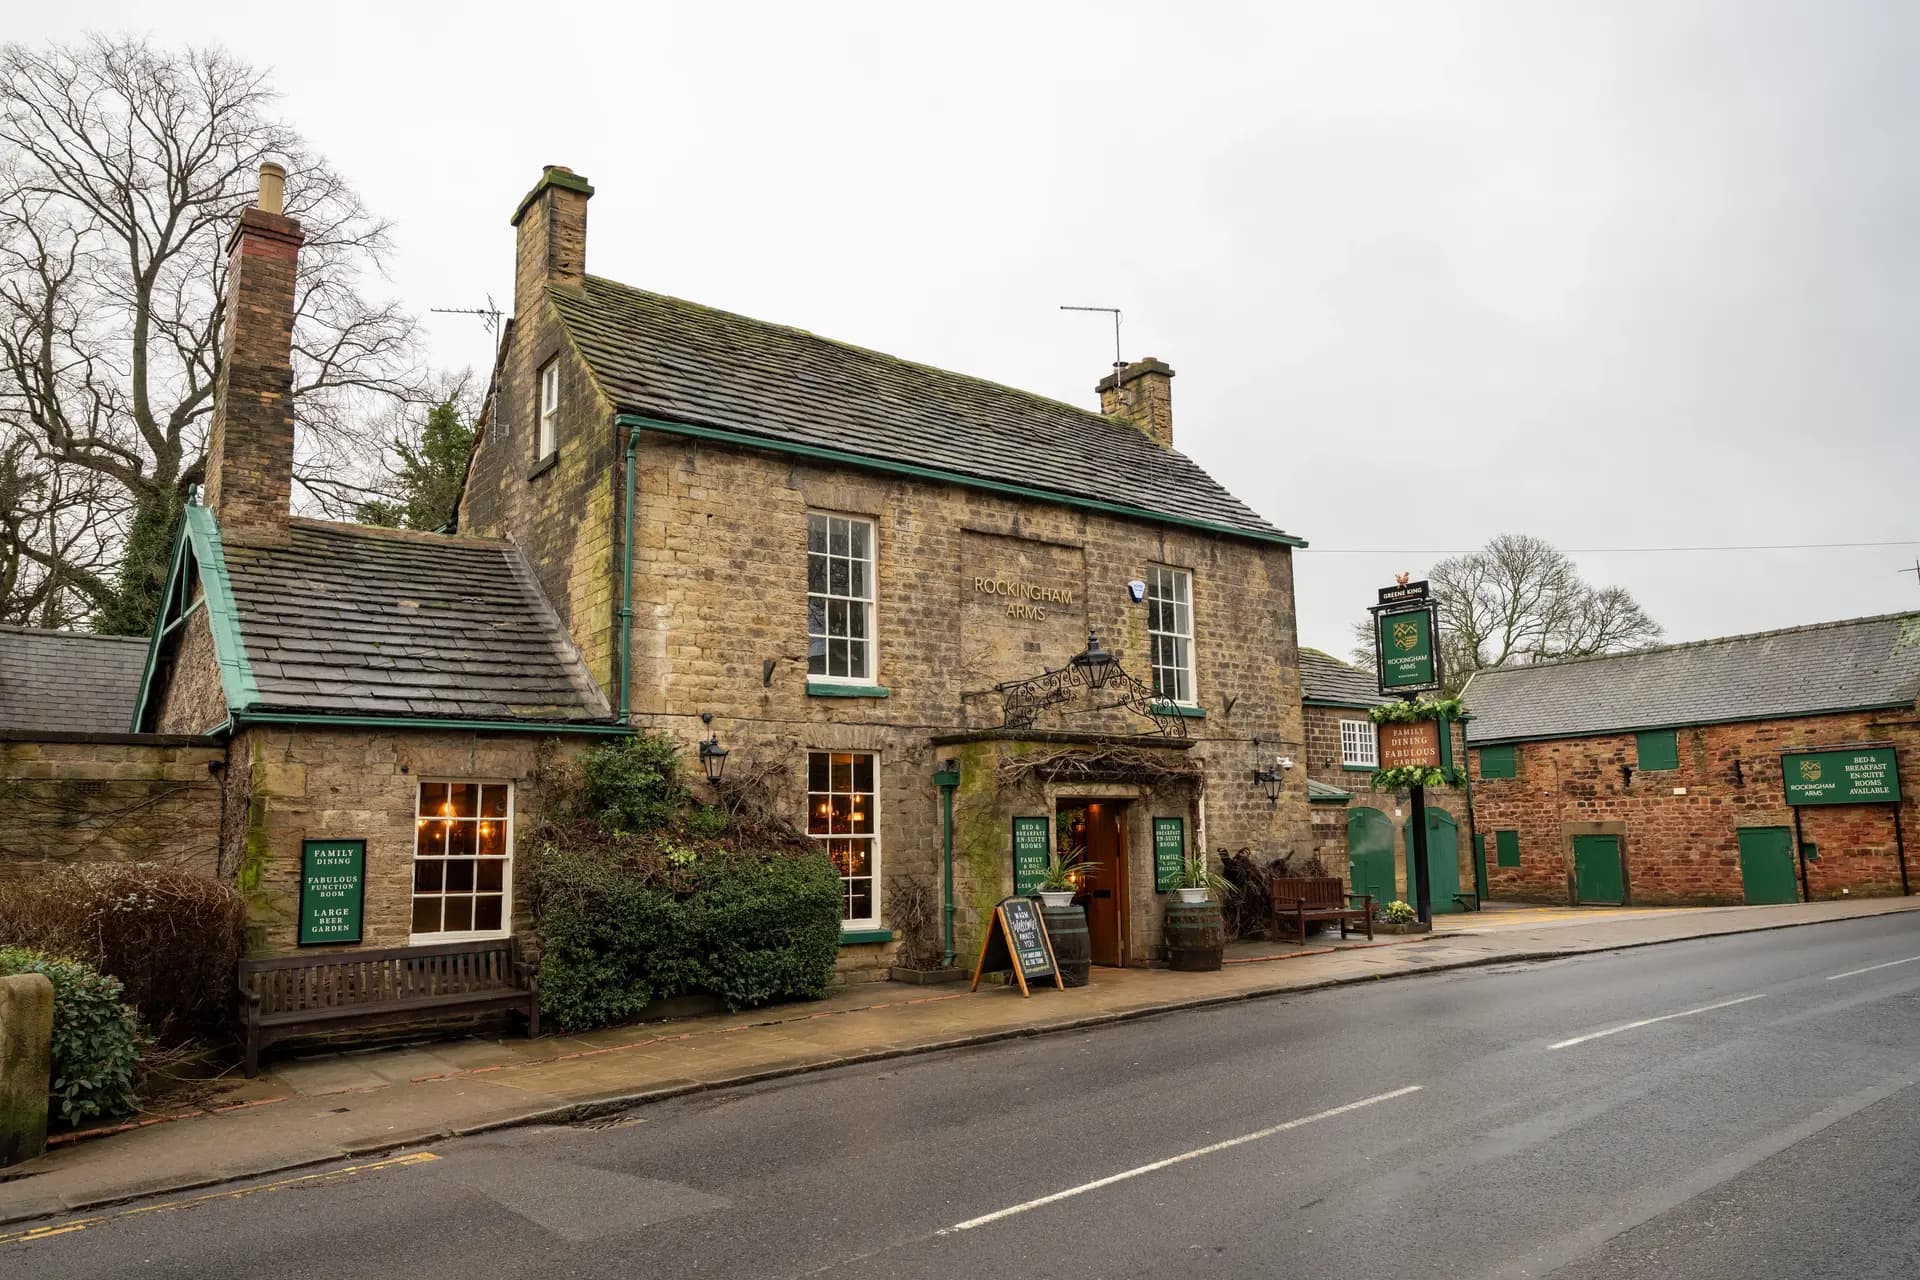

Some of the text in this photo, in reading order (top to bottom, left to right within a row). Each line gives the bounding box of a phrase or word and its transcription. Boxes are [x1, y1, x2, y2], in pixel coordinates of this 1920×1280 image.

[974, 577, 1073, 605] ROCKINGHAM
[1383, 591, 1405, 599] GREENE
[1407, 587, 1422, 595] KING
[1006, 603, 1046, 621] ARMS
[1388, 654, 1427, 665] ROCKINGHAM
[1399, 663, 1416, 671] ARMS
[1393, 728, 1424, 736] FAMILY
[1391, 736, 1428, 746] DINING
[1385, 747, 1436, 758] FABULOUS
[1393, 758, 1428, 766] GARDEN
[1845, 763, 1887, 771] BREAKFAST
[1850, 771, 1885, 779] EN-SUITE
[1790, 783, 1836, 791] ROCKINGHAM
[1849, 787, 1890, 795] AVAILABLE
[314, 849, 354, 857] FAMILY
[308, 876, 358, 884] FABULOUS
[314, 908, 350, 917] LARGE
[319, 917, 343, 925] BEER
[311, 924, 350, 933] GARDEN
